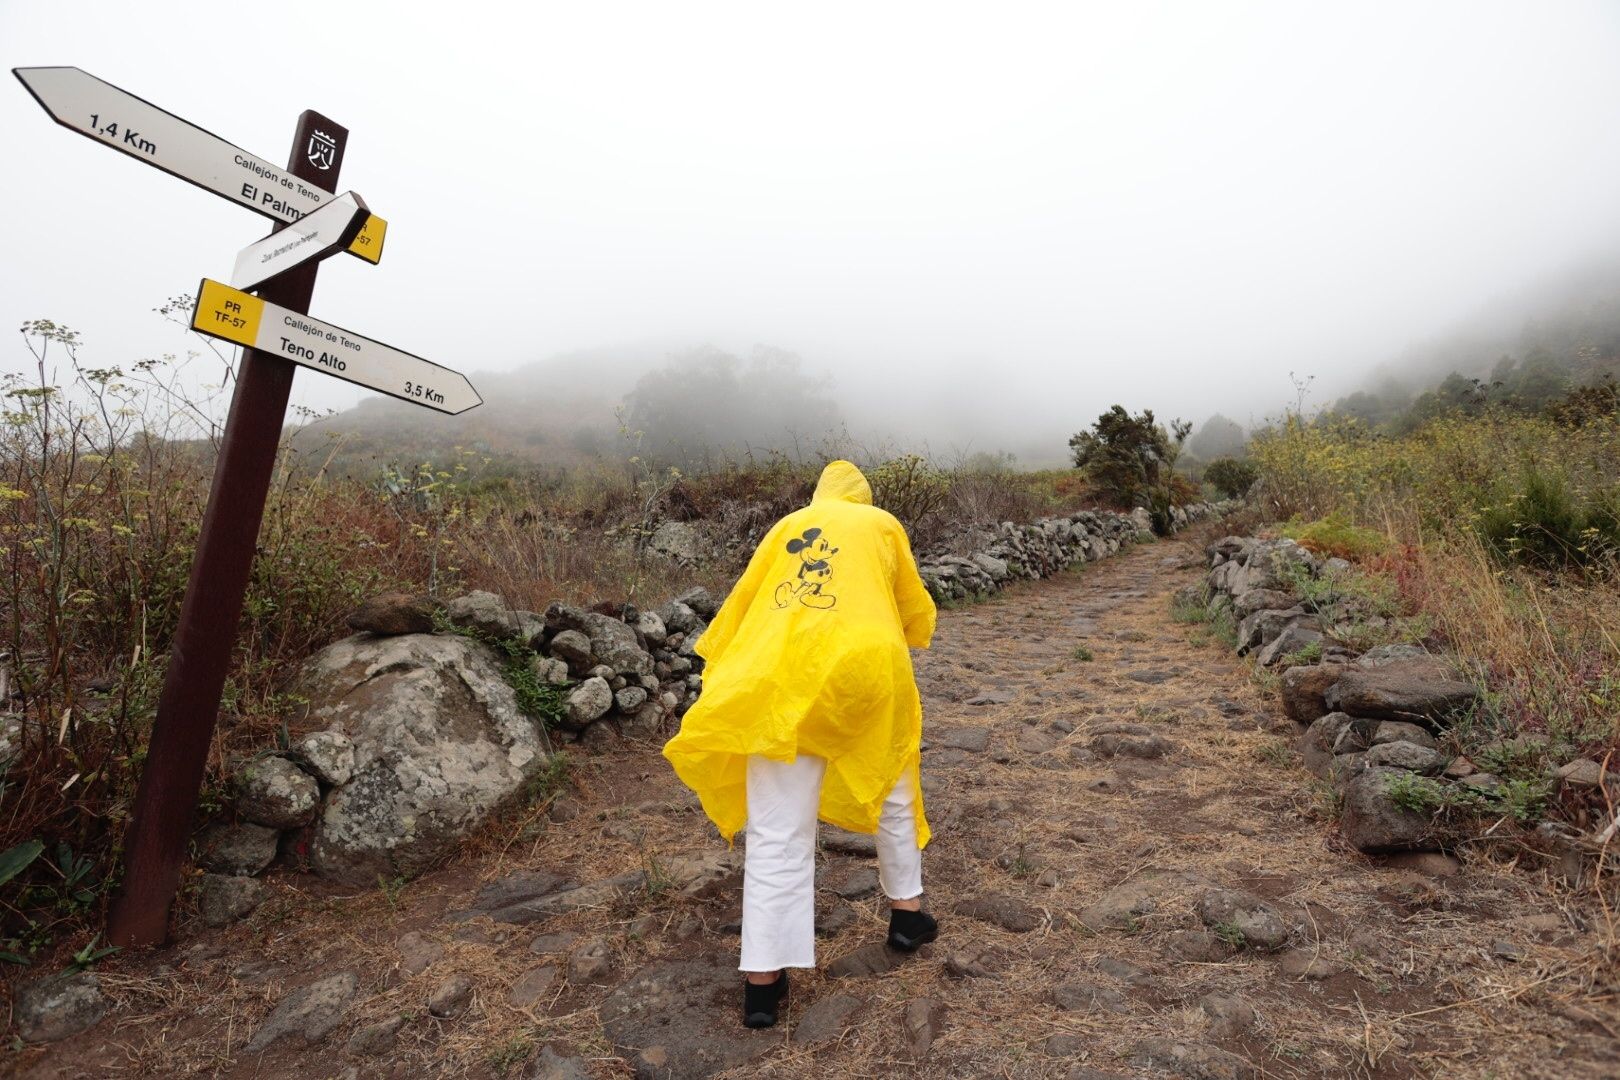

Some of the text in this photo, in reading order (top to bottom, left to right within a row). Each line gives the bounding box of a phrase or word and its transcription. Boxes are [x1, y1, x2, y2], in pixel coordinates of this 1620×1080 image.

[89, 114, 156, 155] 1,4 Km
[234, 155, 320, 202] Callejón de Teno
[241, 183, 258, 201] El
[356, 234, 371, 246] -57
[224, 300, 241, 314] PR
[214, 310, 246, 329] TF-57
[284, 316, 361, 352] Callejón de Teno
[280, 337, 346, 371] Teno Alto
[404, 381, 444, 404] 3,5 Km
